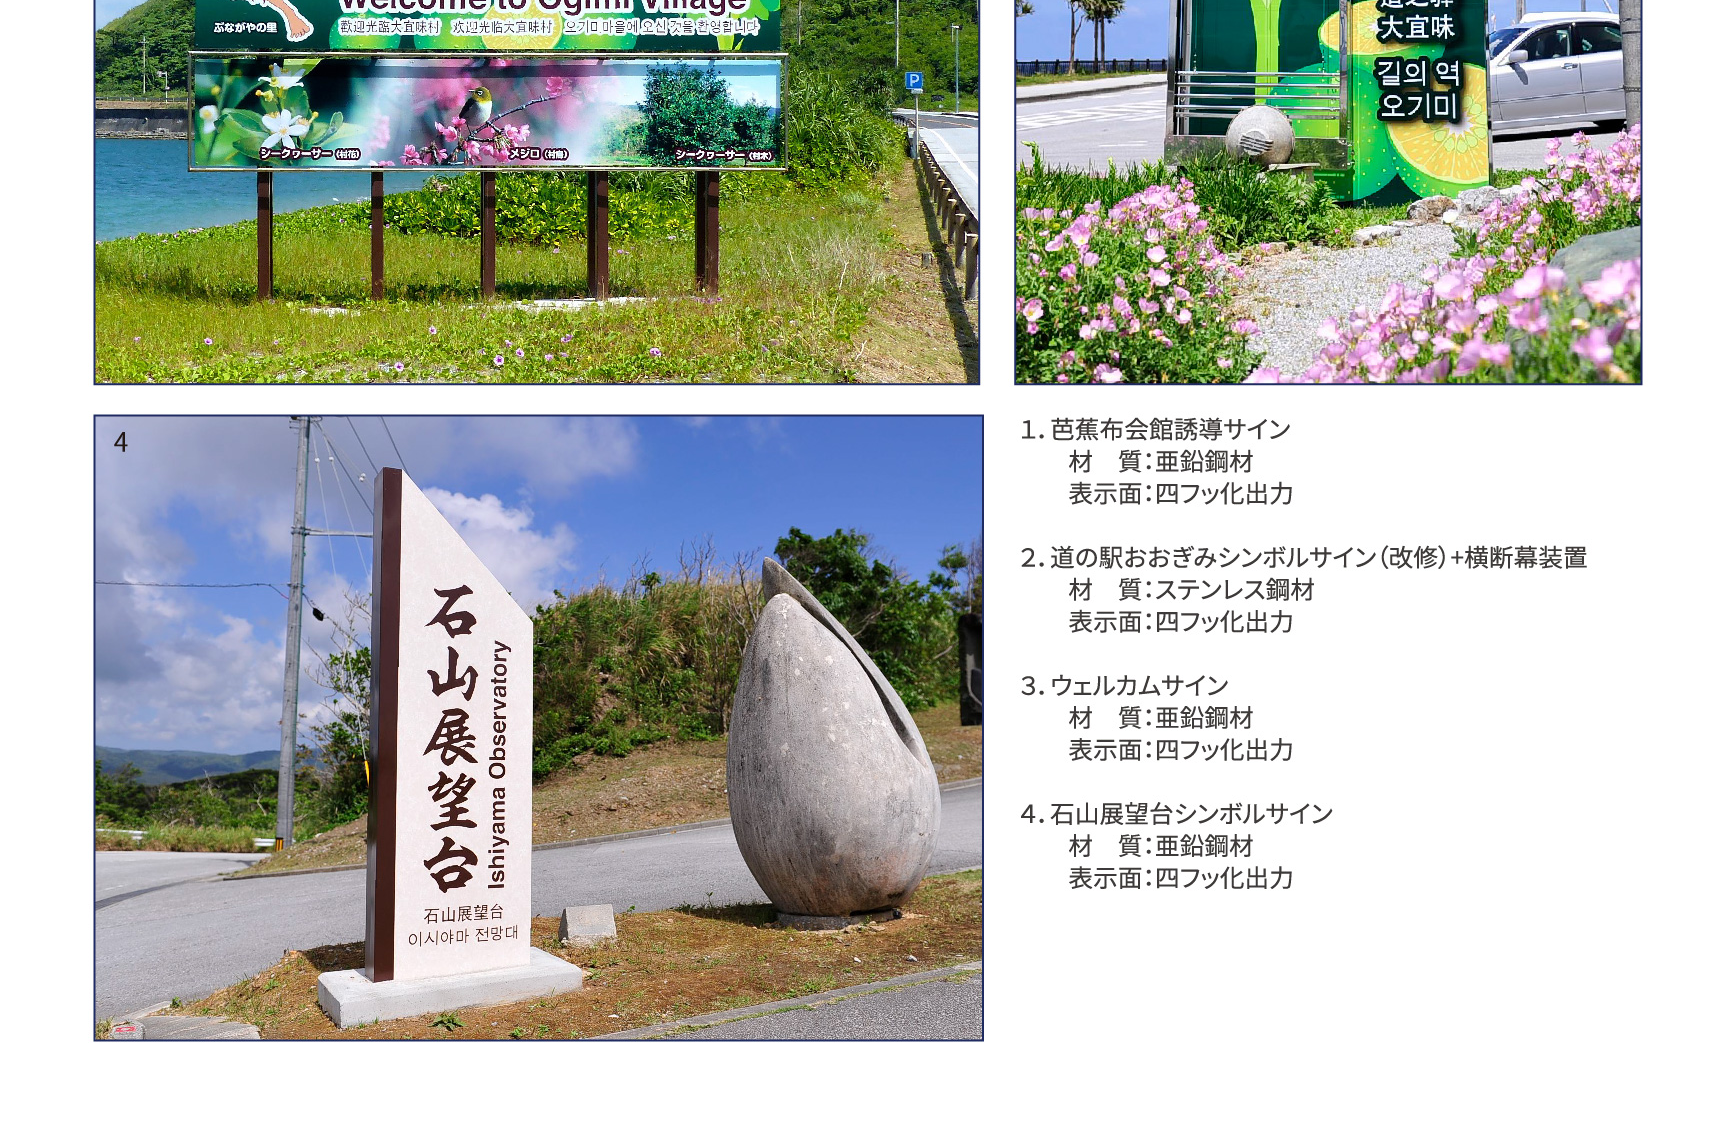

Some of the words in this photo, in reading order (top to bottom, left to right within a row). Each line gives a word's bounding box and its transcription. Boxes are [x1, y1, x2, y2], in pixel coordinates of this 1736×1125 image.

[1381, 13, 1456, 40] 大宜味
[909, 74, 920, 87] P
[1377, 60, 1426, 87] 길의
[1436, 60, 1460, 88] 역
[1381, 92, 1457, 119] 오기미
[488, 639, 512, 780] Observatory
[423, 584, 480, 894] 石山展望台
[487, 786, 510, 890] Ishiyama
[423, 902, 504, 925] 石山展望台
[408, 928, 470, 948] 이시야마
[474, 923, 520, 944] 전망대
